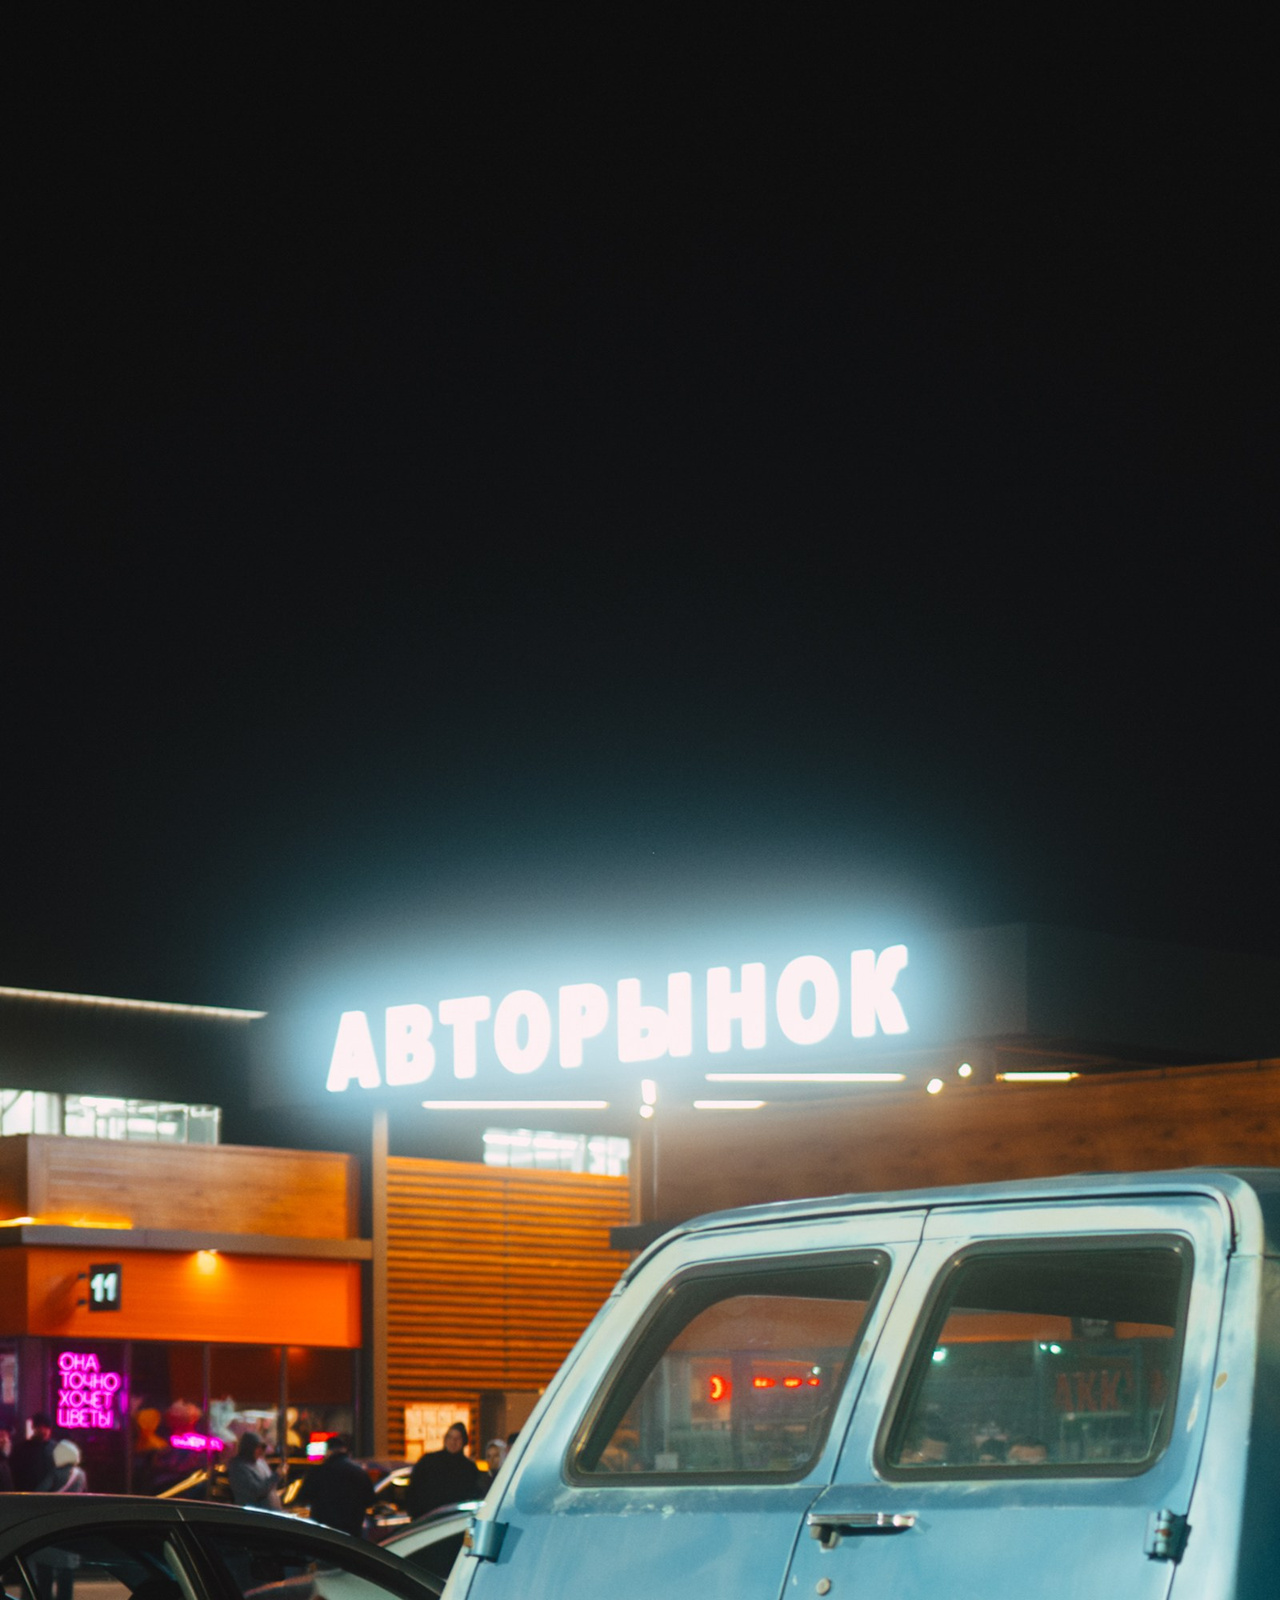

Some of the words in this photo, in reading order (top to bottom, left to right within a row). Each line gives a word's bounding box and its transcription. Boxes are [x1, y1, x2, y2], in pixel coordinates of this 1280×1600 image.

[325, 944, 909, 1092] АВТОРЫНОК
[90, 1272, 117, 1302] 11
[57, 1352, 99, 1372] ОНА
[59, 1371, 121, 1392] ТОЧНО
[58, 1389, 114, 1409] ХОЧЕТ
[57, 1408, 114, 1428] ЦВЕТЫ
